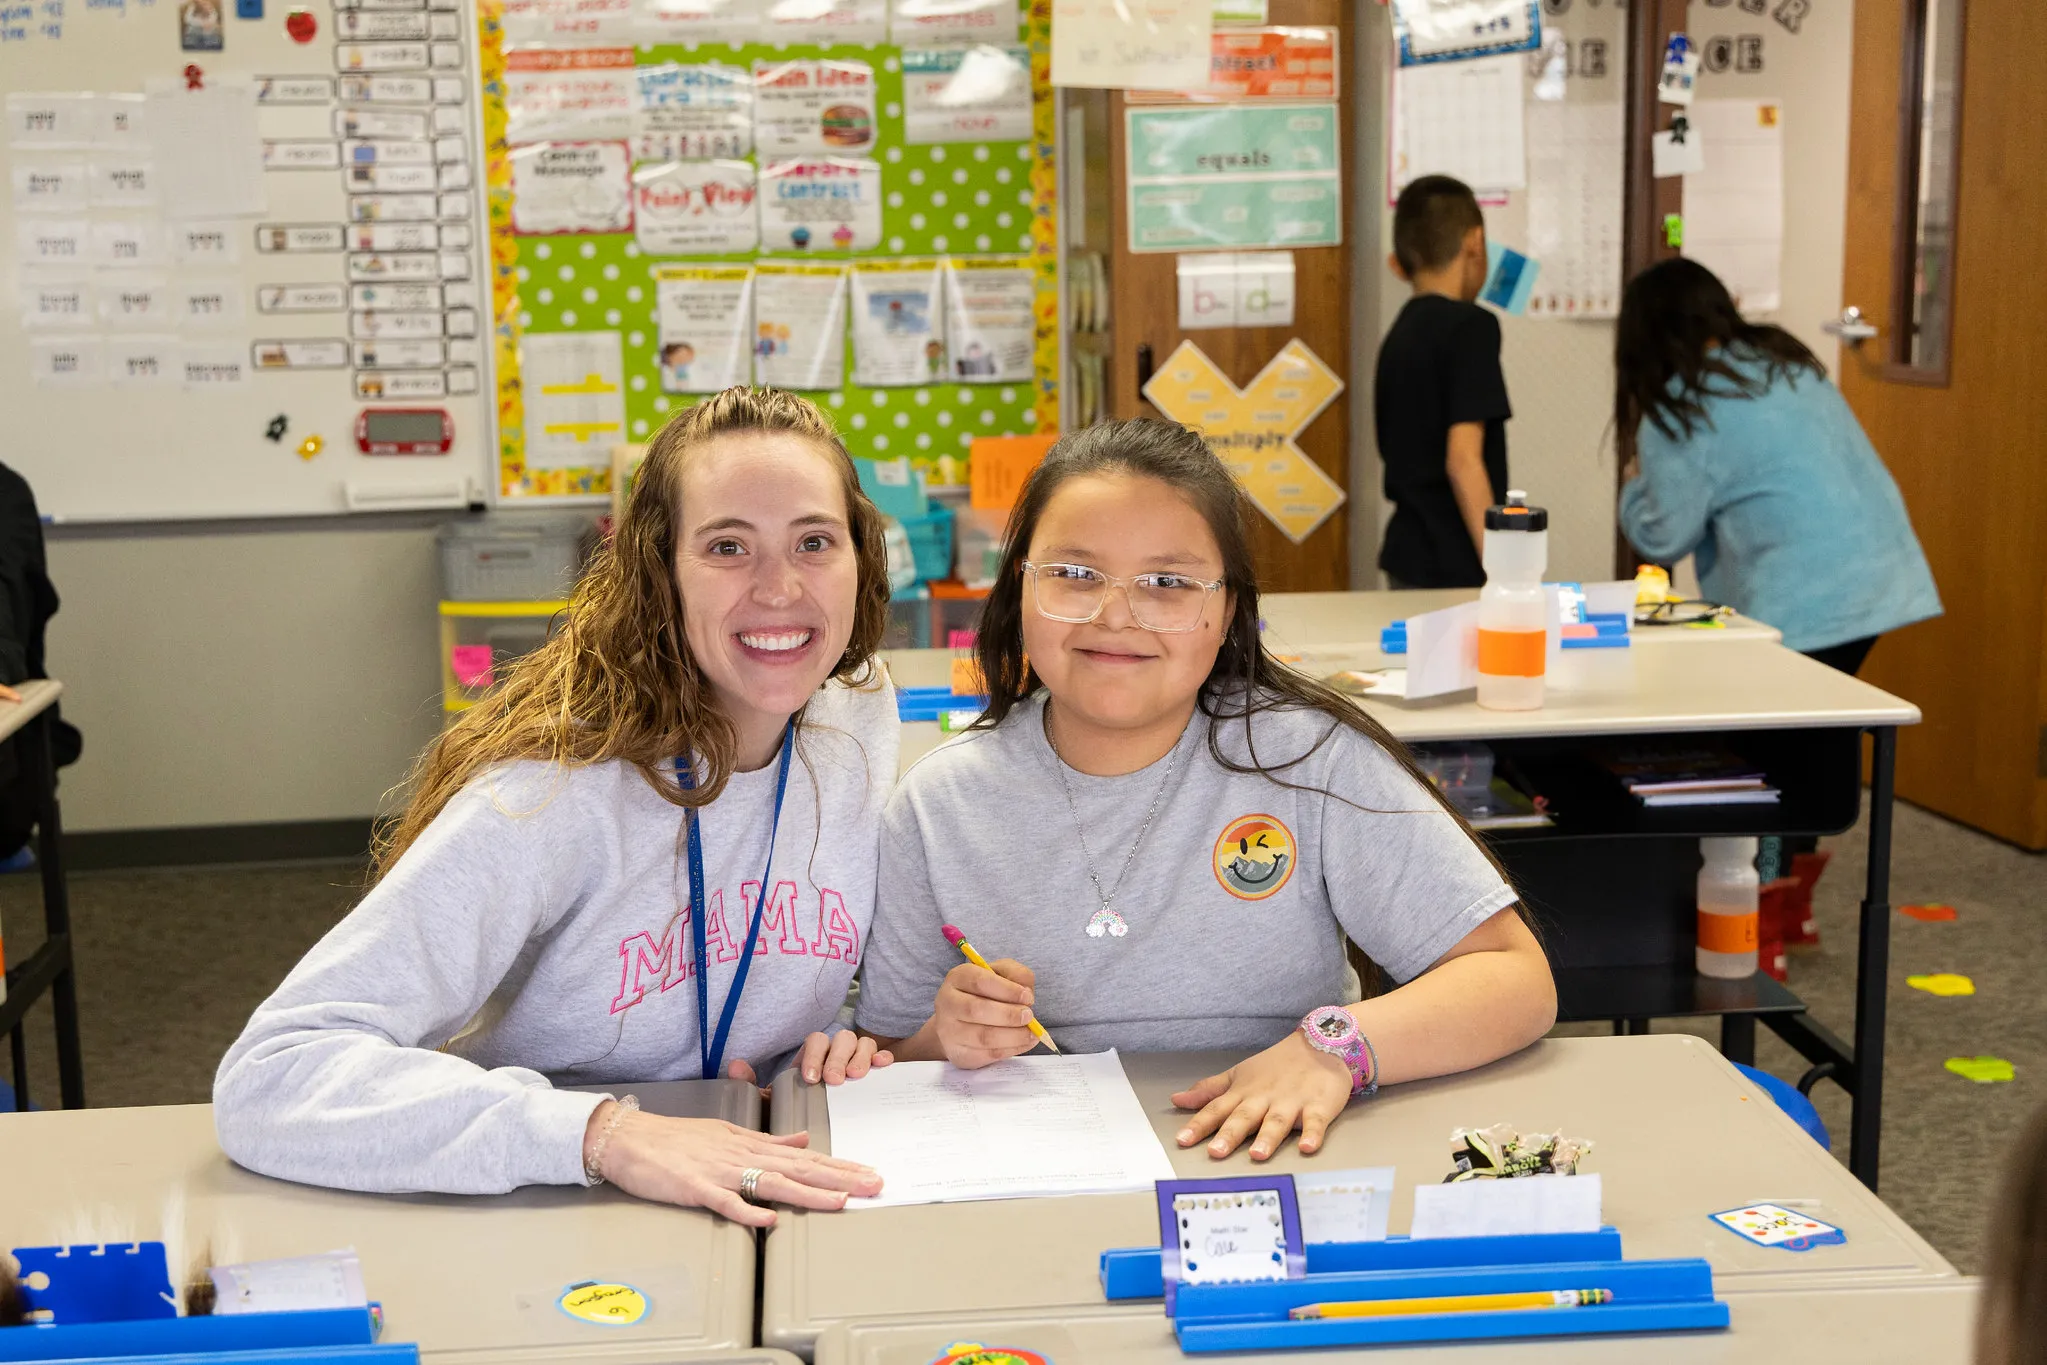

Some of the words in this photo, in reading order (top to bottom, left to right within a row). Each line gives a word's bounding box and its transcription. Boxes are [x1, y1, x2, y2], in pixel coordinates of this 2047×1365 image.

[1196, 149, 1271, 172] equals
[703, 181, 757, 206] View
[1204, 430, 1286, 452] multiply
[610, 880, 858, 1015] MAMA
